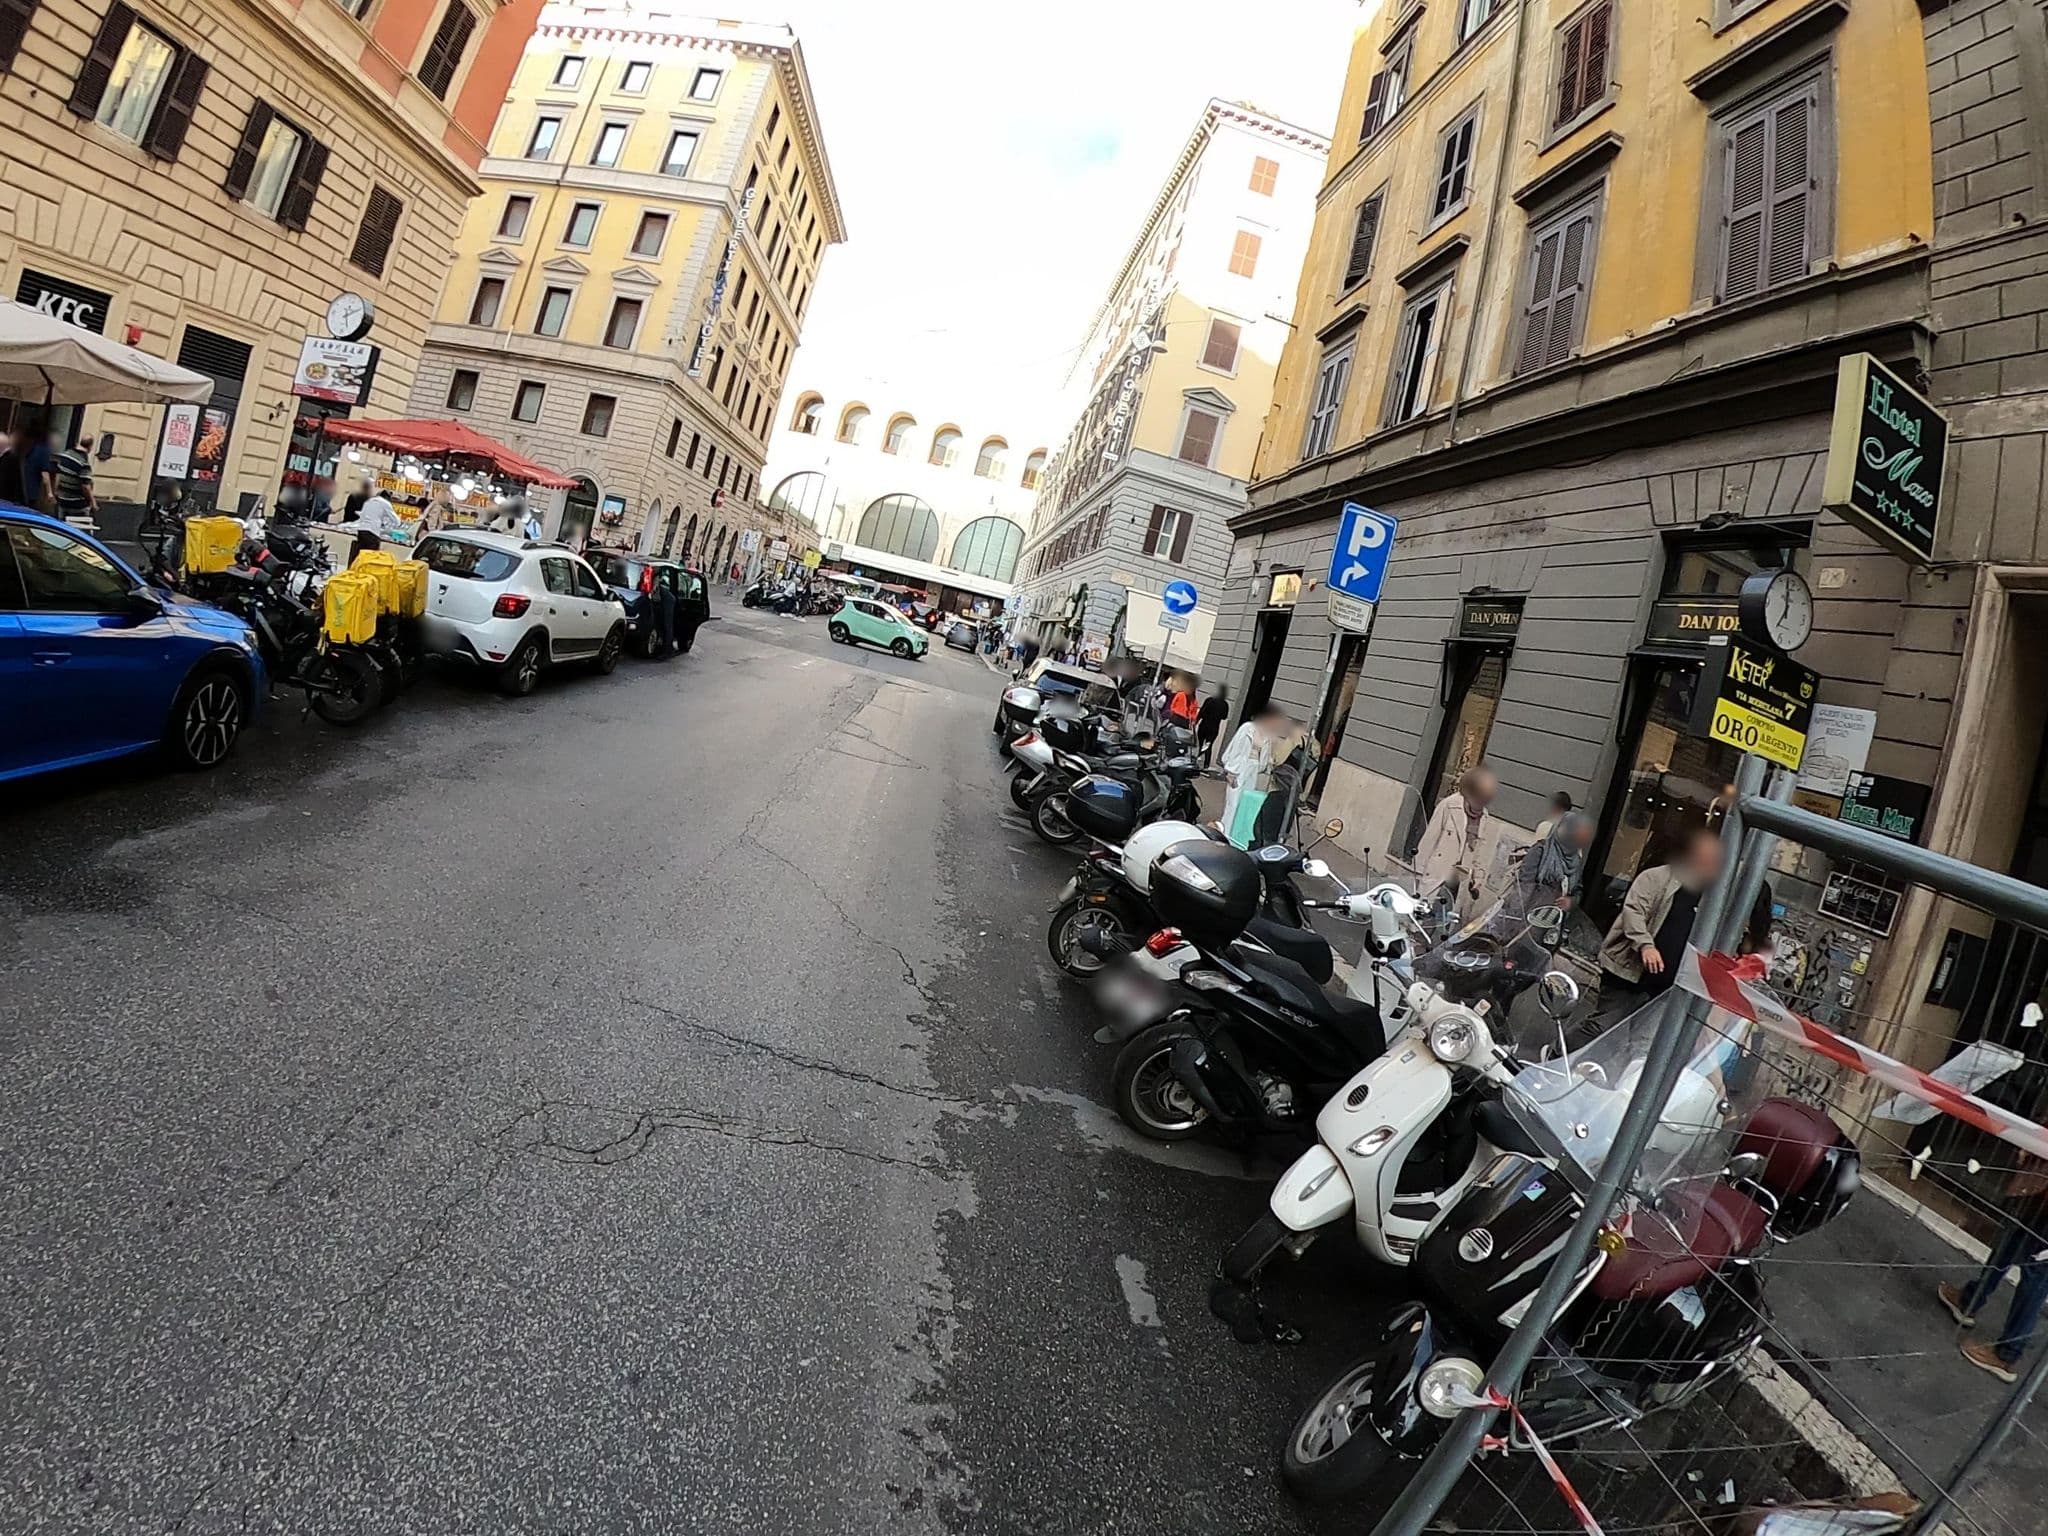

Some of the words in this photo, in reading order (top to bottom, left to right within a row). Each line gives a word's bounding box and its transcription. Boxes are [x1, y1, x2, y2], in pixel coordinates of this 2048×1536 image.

[35, 289, 94, 328] KFC
[692, 313, 717, 370] HOTEL
[1112, 355, 1142, 449] GIOBERTI
[1867, 374, 1923, 448] Hotel
[168, 462, 185, 472] KFC
[1347, 514, 1386, 558] P
[1470, 612, 1491, 624] DAN
[1489, 612, 1520, 627] JOHN
[1678, 614, 1711, 630] DAN
[1727, 645, 1768, 690] KETER
[1783, 702, 1797, 721] 7
[1716, 714, 1758, 747] ORO
[1760, 734, 1799, 756] ARGENTO
